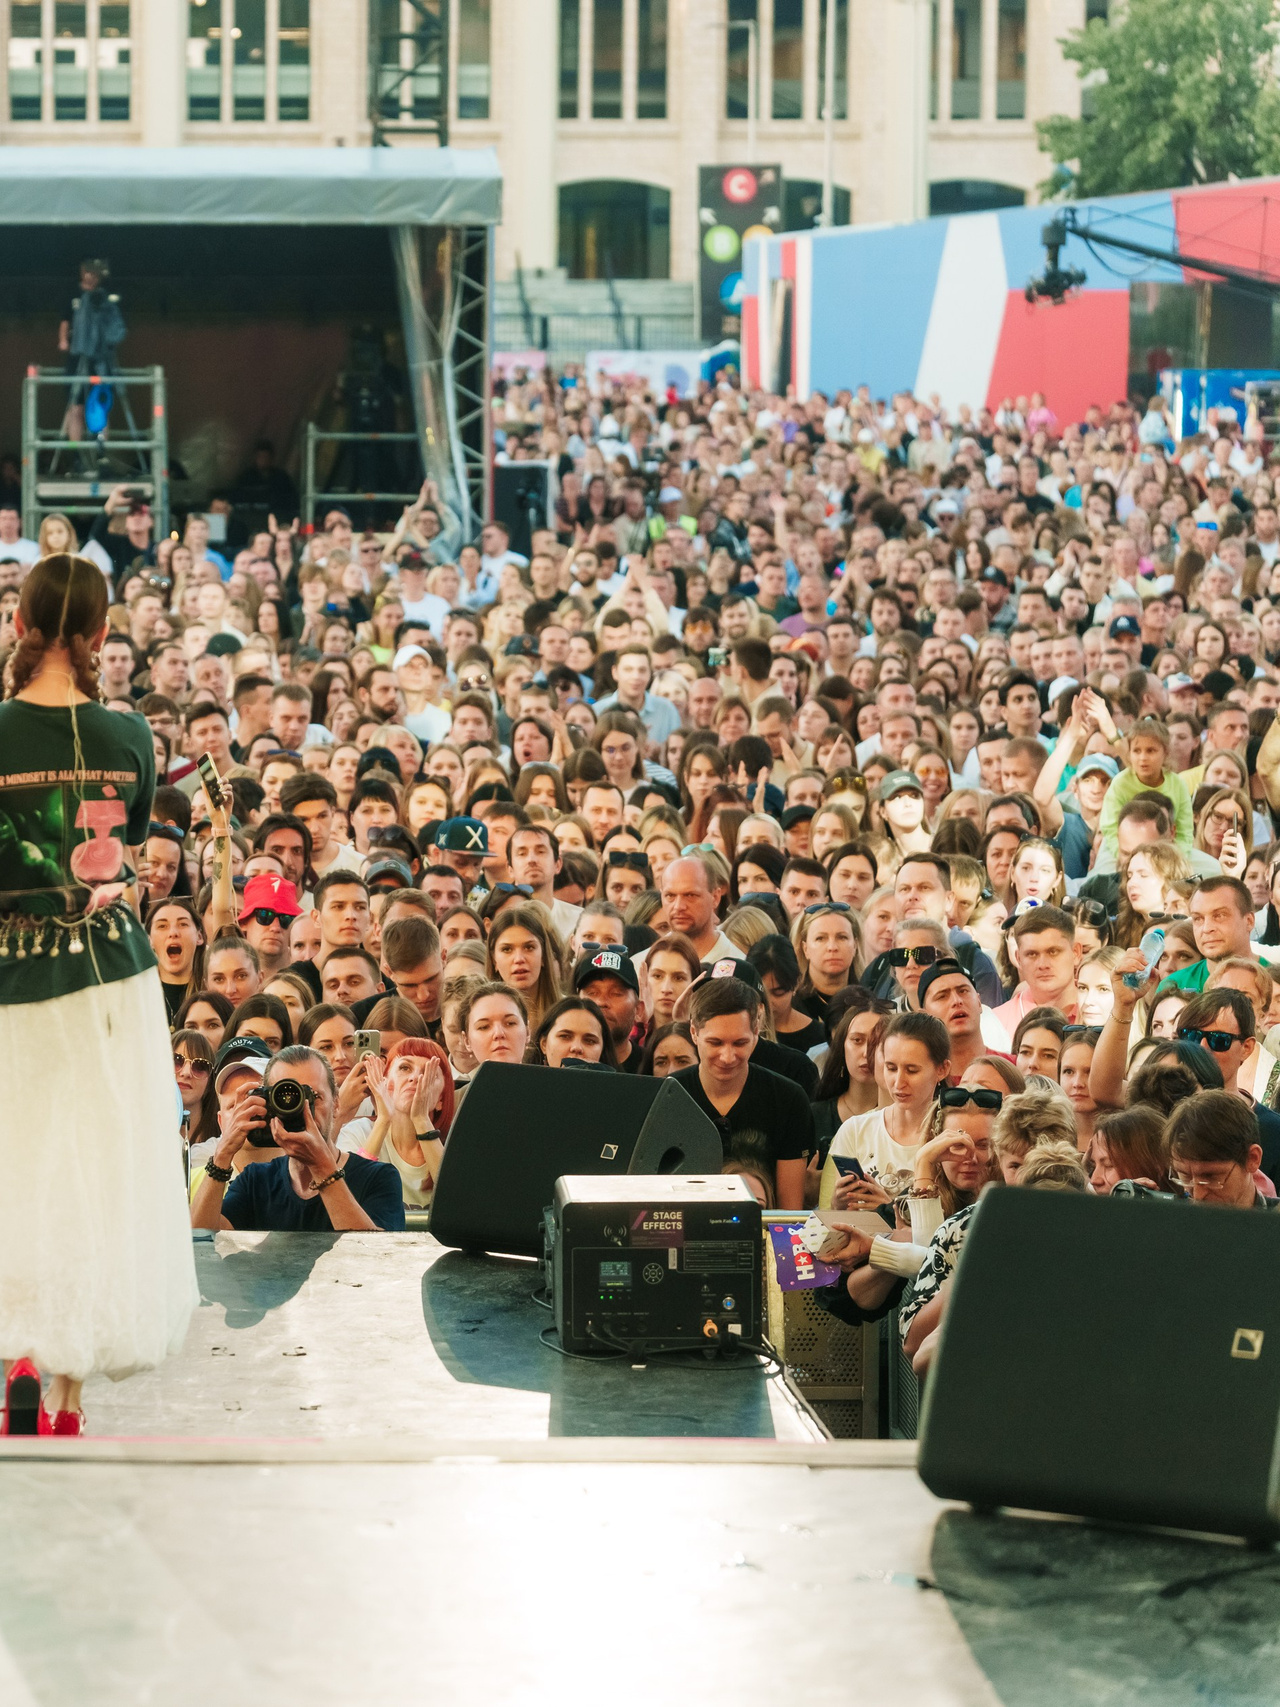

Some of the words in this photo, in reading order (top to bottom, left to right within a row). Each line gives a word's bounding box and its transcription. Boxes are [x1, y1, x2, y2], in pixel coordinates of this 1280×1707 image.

[730, 174, 748, 198] C
[6, 771, 46, 785] MINDSET
[47, 770, 57, 782] IS
[58, 770, 75, 780] ALL
[465, 825, 485, 849] X
[228, 1038, 253, 1048] YOUTH
[652, 1211, 683, 1220] STAGE
[642, 1221, 683, 1230] EFFECTS
